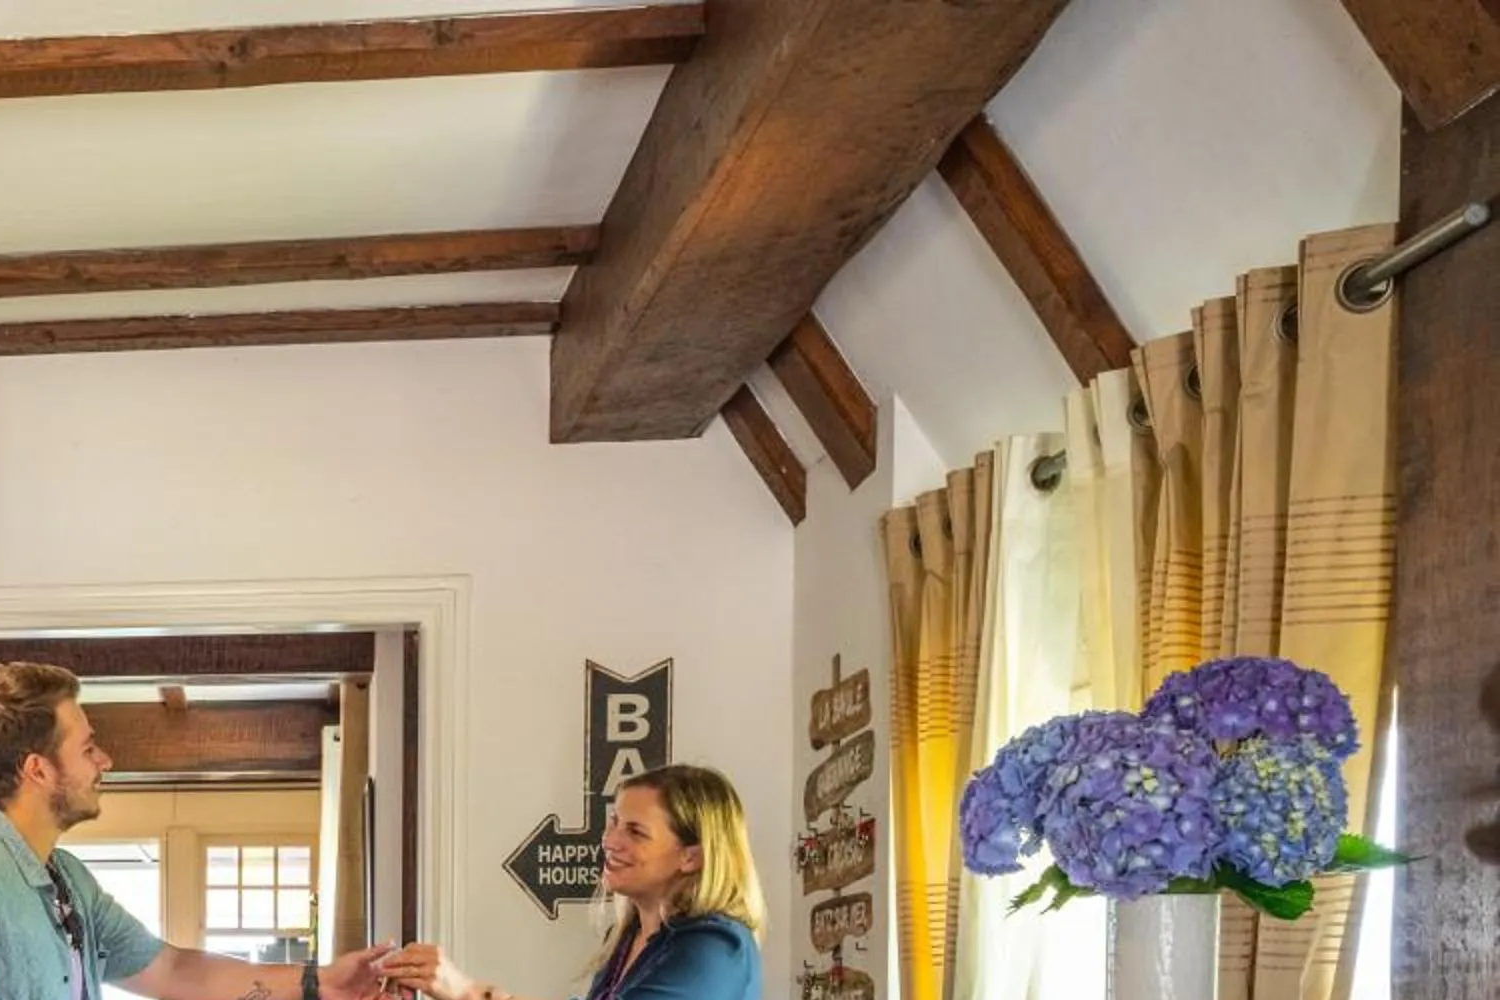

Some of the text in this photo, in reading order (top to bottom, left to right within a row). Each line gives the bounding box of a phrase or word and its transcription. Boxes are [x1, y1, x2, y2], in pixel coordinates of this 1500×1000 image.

[601, 692, 651, 828] BA
[537, 844, 600, 863] HAPPY
[538, 866, 600, 885] HOURS
